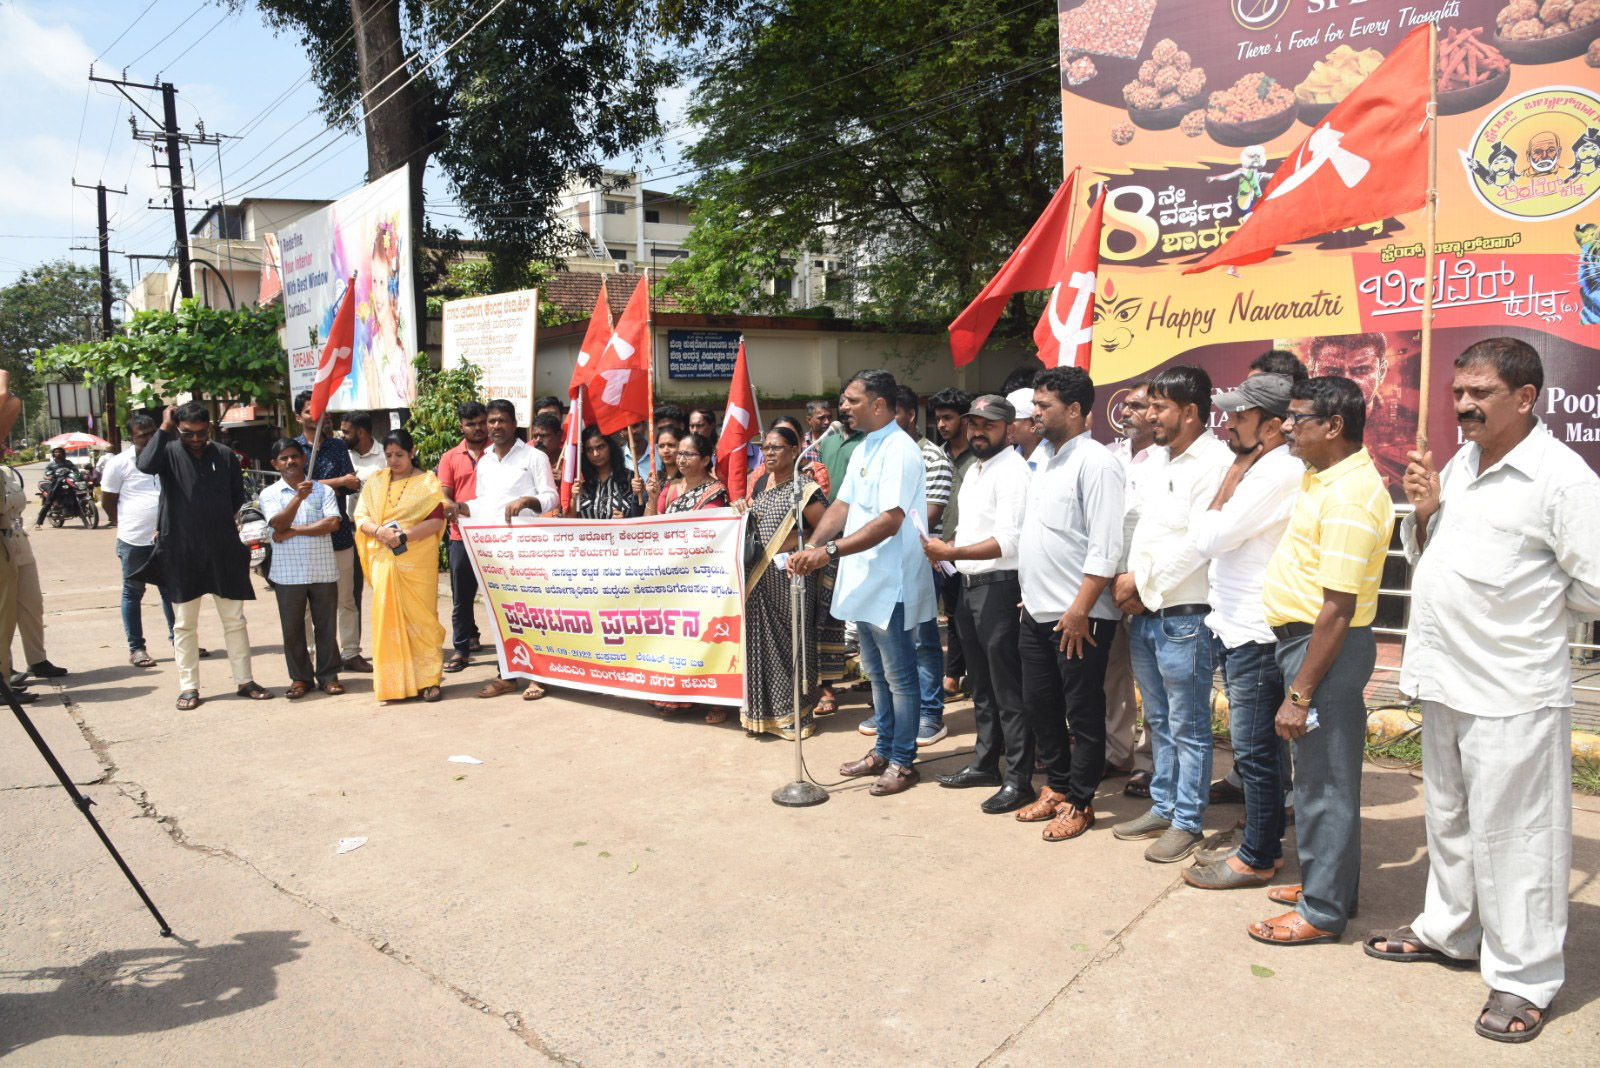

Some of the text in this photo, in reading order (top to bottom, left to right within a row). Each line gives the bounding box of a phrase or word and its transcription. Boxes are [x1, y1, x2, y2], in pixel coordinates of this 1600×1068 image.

[1237, 35, 1282, 60] There's
[1288, 30, 1319, 50] Food
[1324, 23, 1345, 44] for
[1350, 17, 1390, 37] Every
[1399, 0, 1460, 31] Thoughts
[294, 252, 313, 270] Interior
[286, 270, 328, 297] With Best Window
[1146, 289, 1344, 339] Happy Navaratri
[292, 350, 315, 369] DREAMS
[517, 534, 549, 543] ಸರಕಾರಿ
[553, 533, 575, 542] ನಗರ
[578, 530, 615, 545] ಆರೋಗ್ಯ
[619, 530, 659, 543] ಕೇಂದ್ರದಲ್ಲಿ
[501, 601, 700, 645] ಪ್ರತಿಭಟನಾ ಪ್ರದರ್ಶನ
[590, 667, 646, 685] ಮಂಗಳೂರು
[650, 675, 676, 688] ನಗರ
[680, 677, 717, 689] ಸಮಿತಿ
